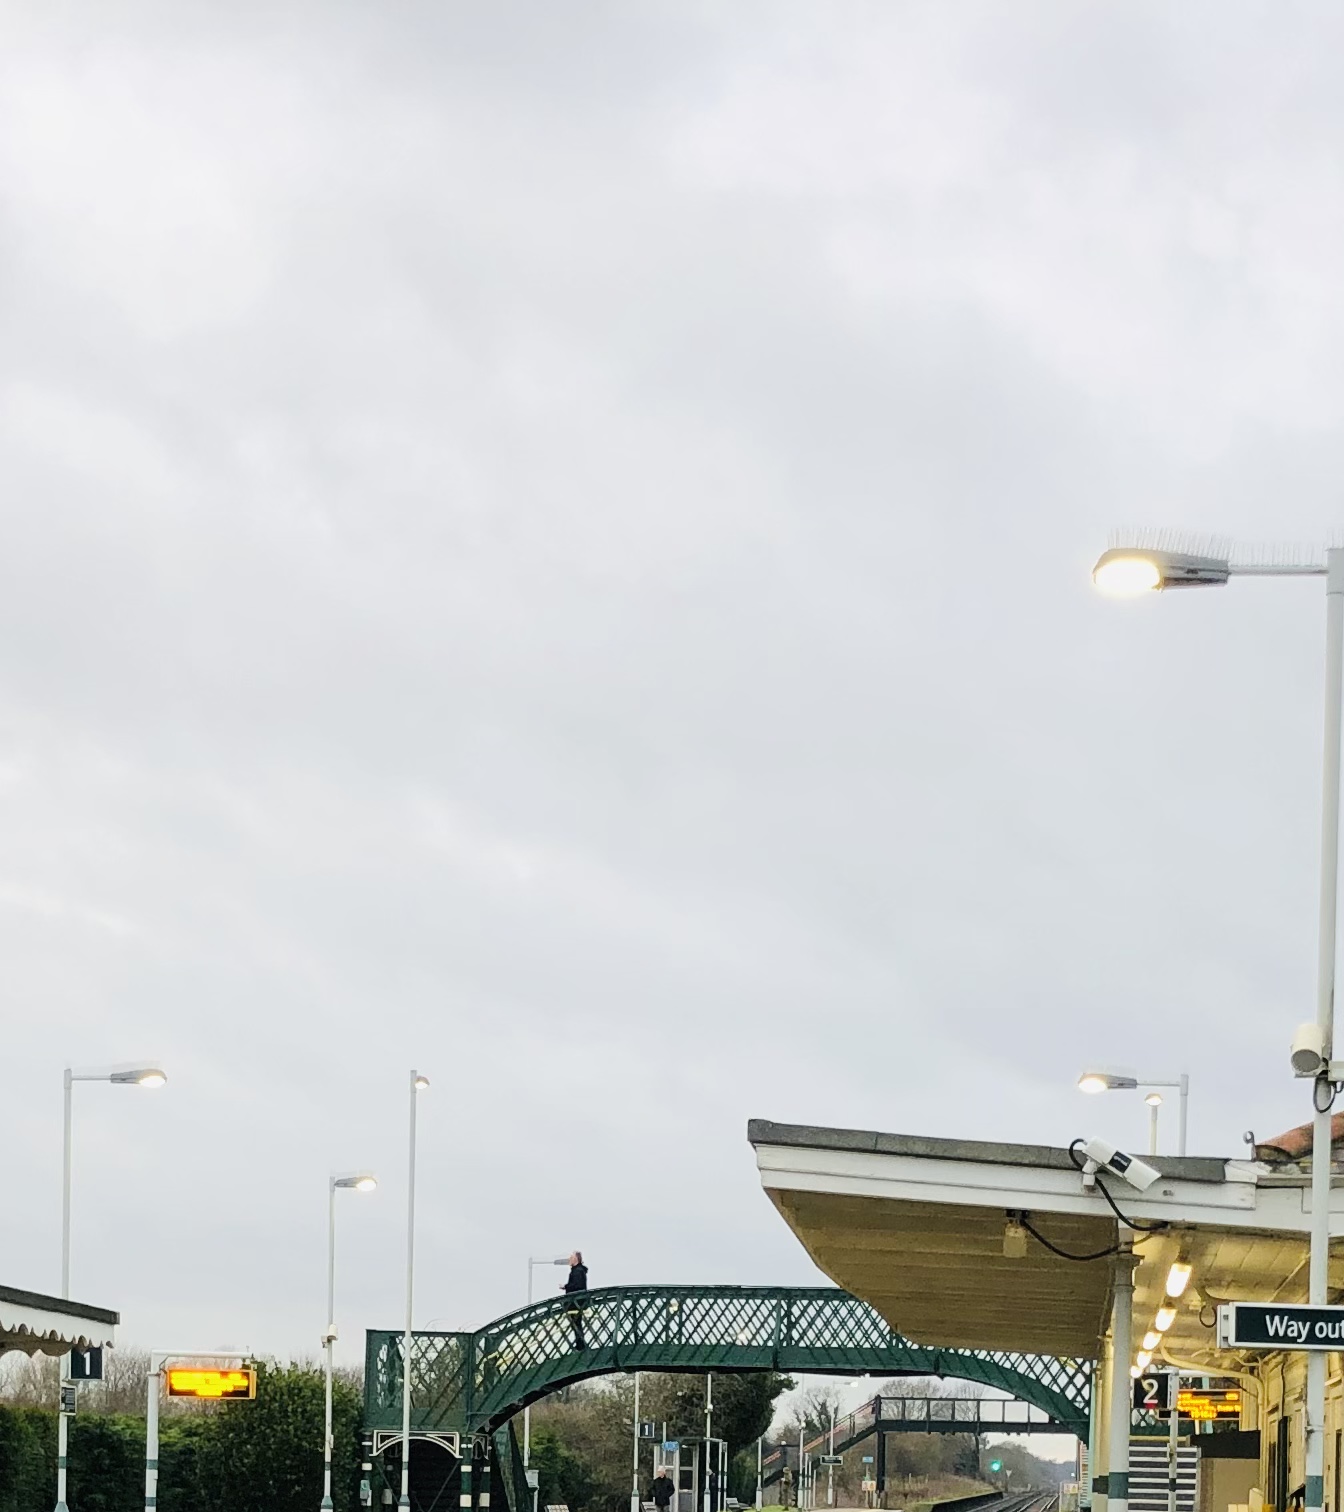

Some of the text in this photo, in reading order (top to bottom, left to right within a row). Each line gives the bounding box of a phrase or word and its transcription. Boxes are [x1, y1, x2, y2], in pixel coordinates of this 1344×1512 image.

[1265, 1314, 1311, 1343] Way
[83, 1351, 91, 1376] 1
[1143, 1378, 1159, 1404] 2
[644, 1424, 649, 1436] 1
